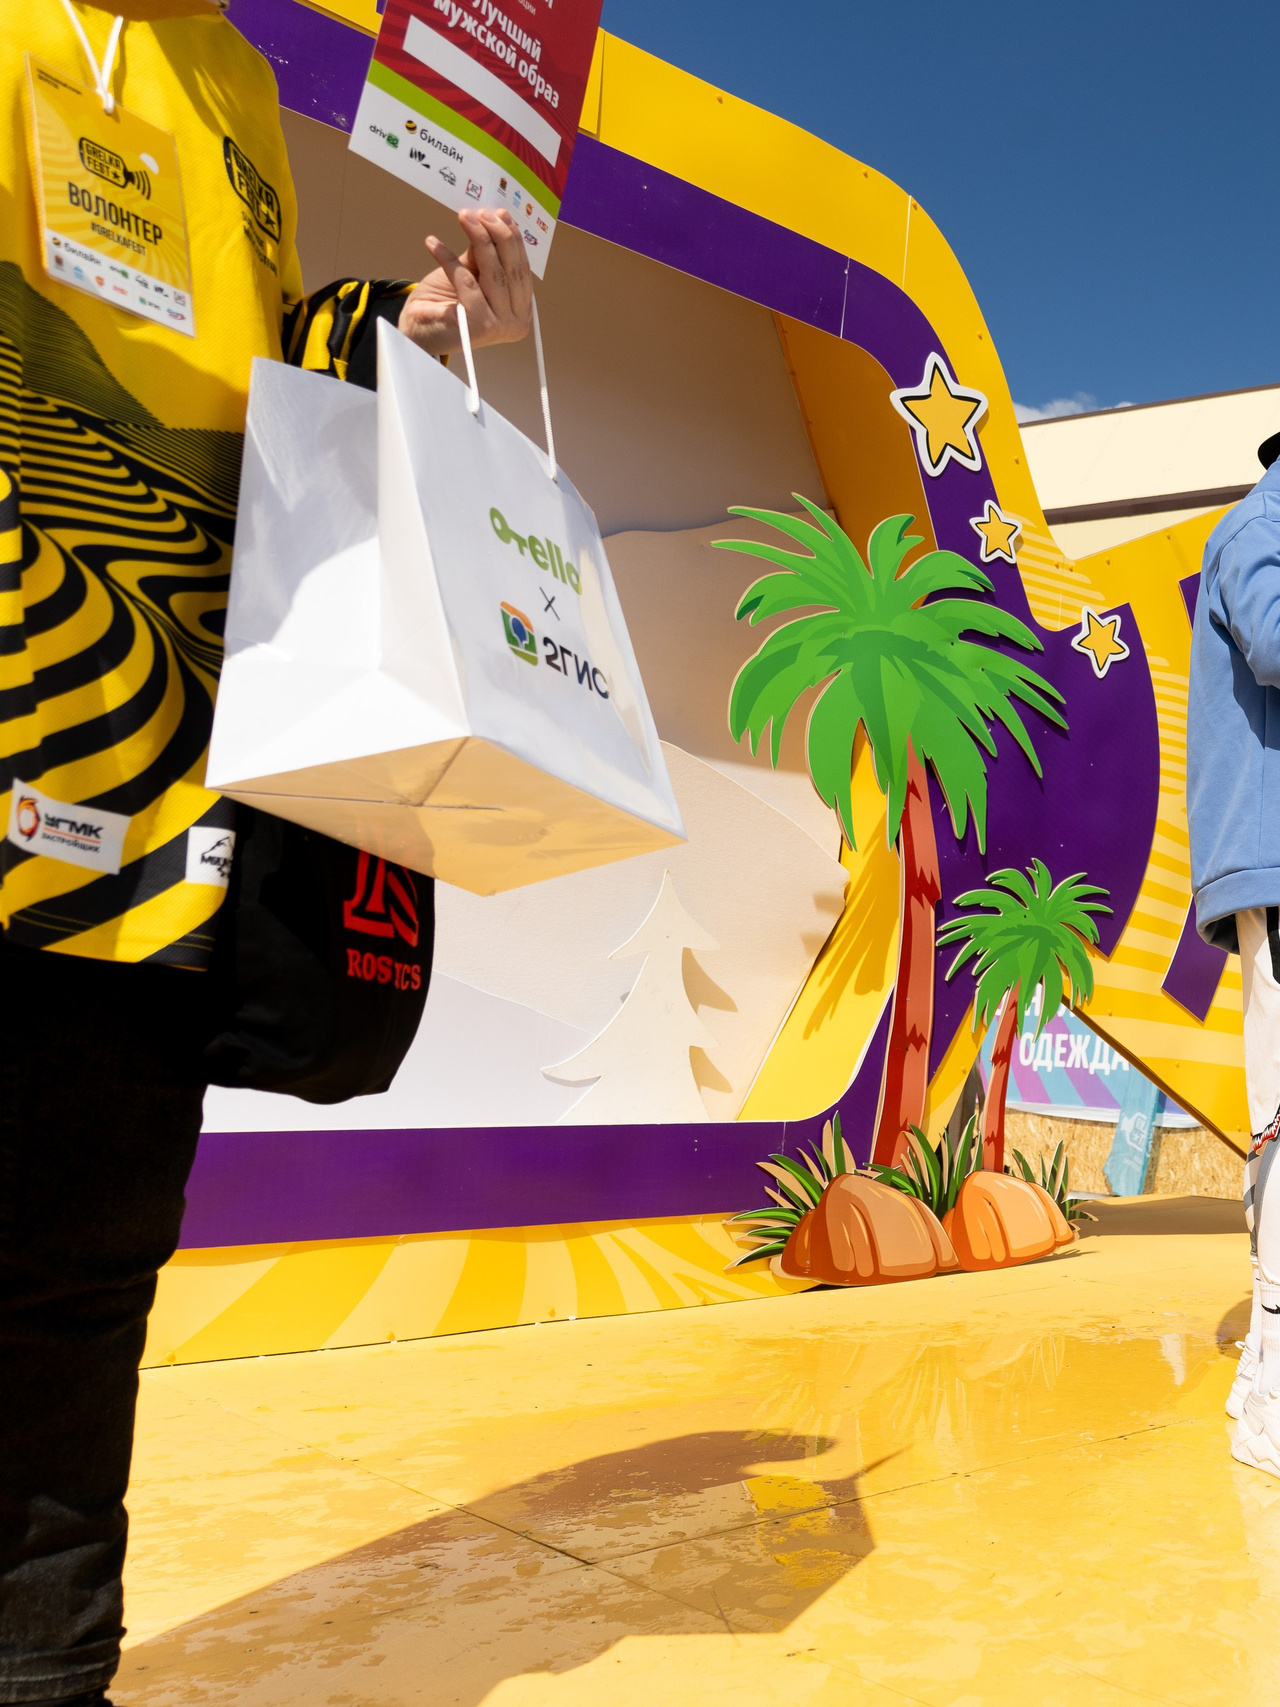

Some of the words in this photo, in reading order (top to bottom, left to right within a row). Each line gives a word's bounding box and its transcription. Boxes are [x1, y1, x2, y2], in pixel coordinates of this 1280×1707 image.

[518, 59, 559, 109] образ
[87, 156, 111, 177] FEST
[419, 128, 464, 164] билайн
[68, 181, 163, 246] ВОЛОНТЕР
[542, 636, 610, 699] 2ГИС
[44, 813, 104, 839] УГМК
